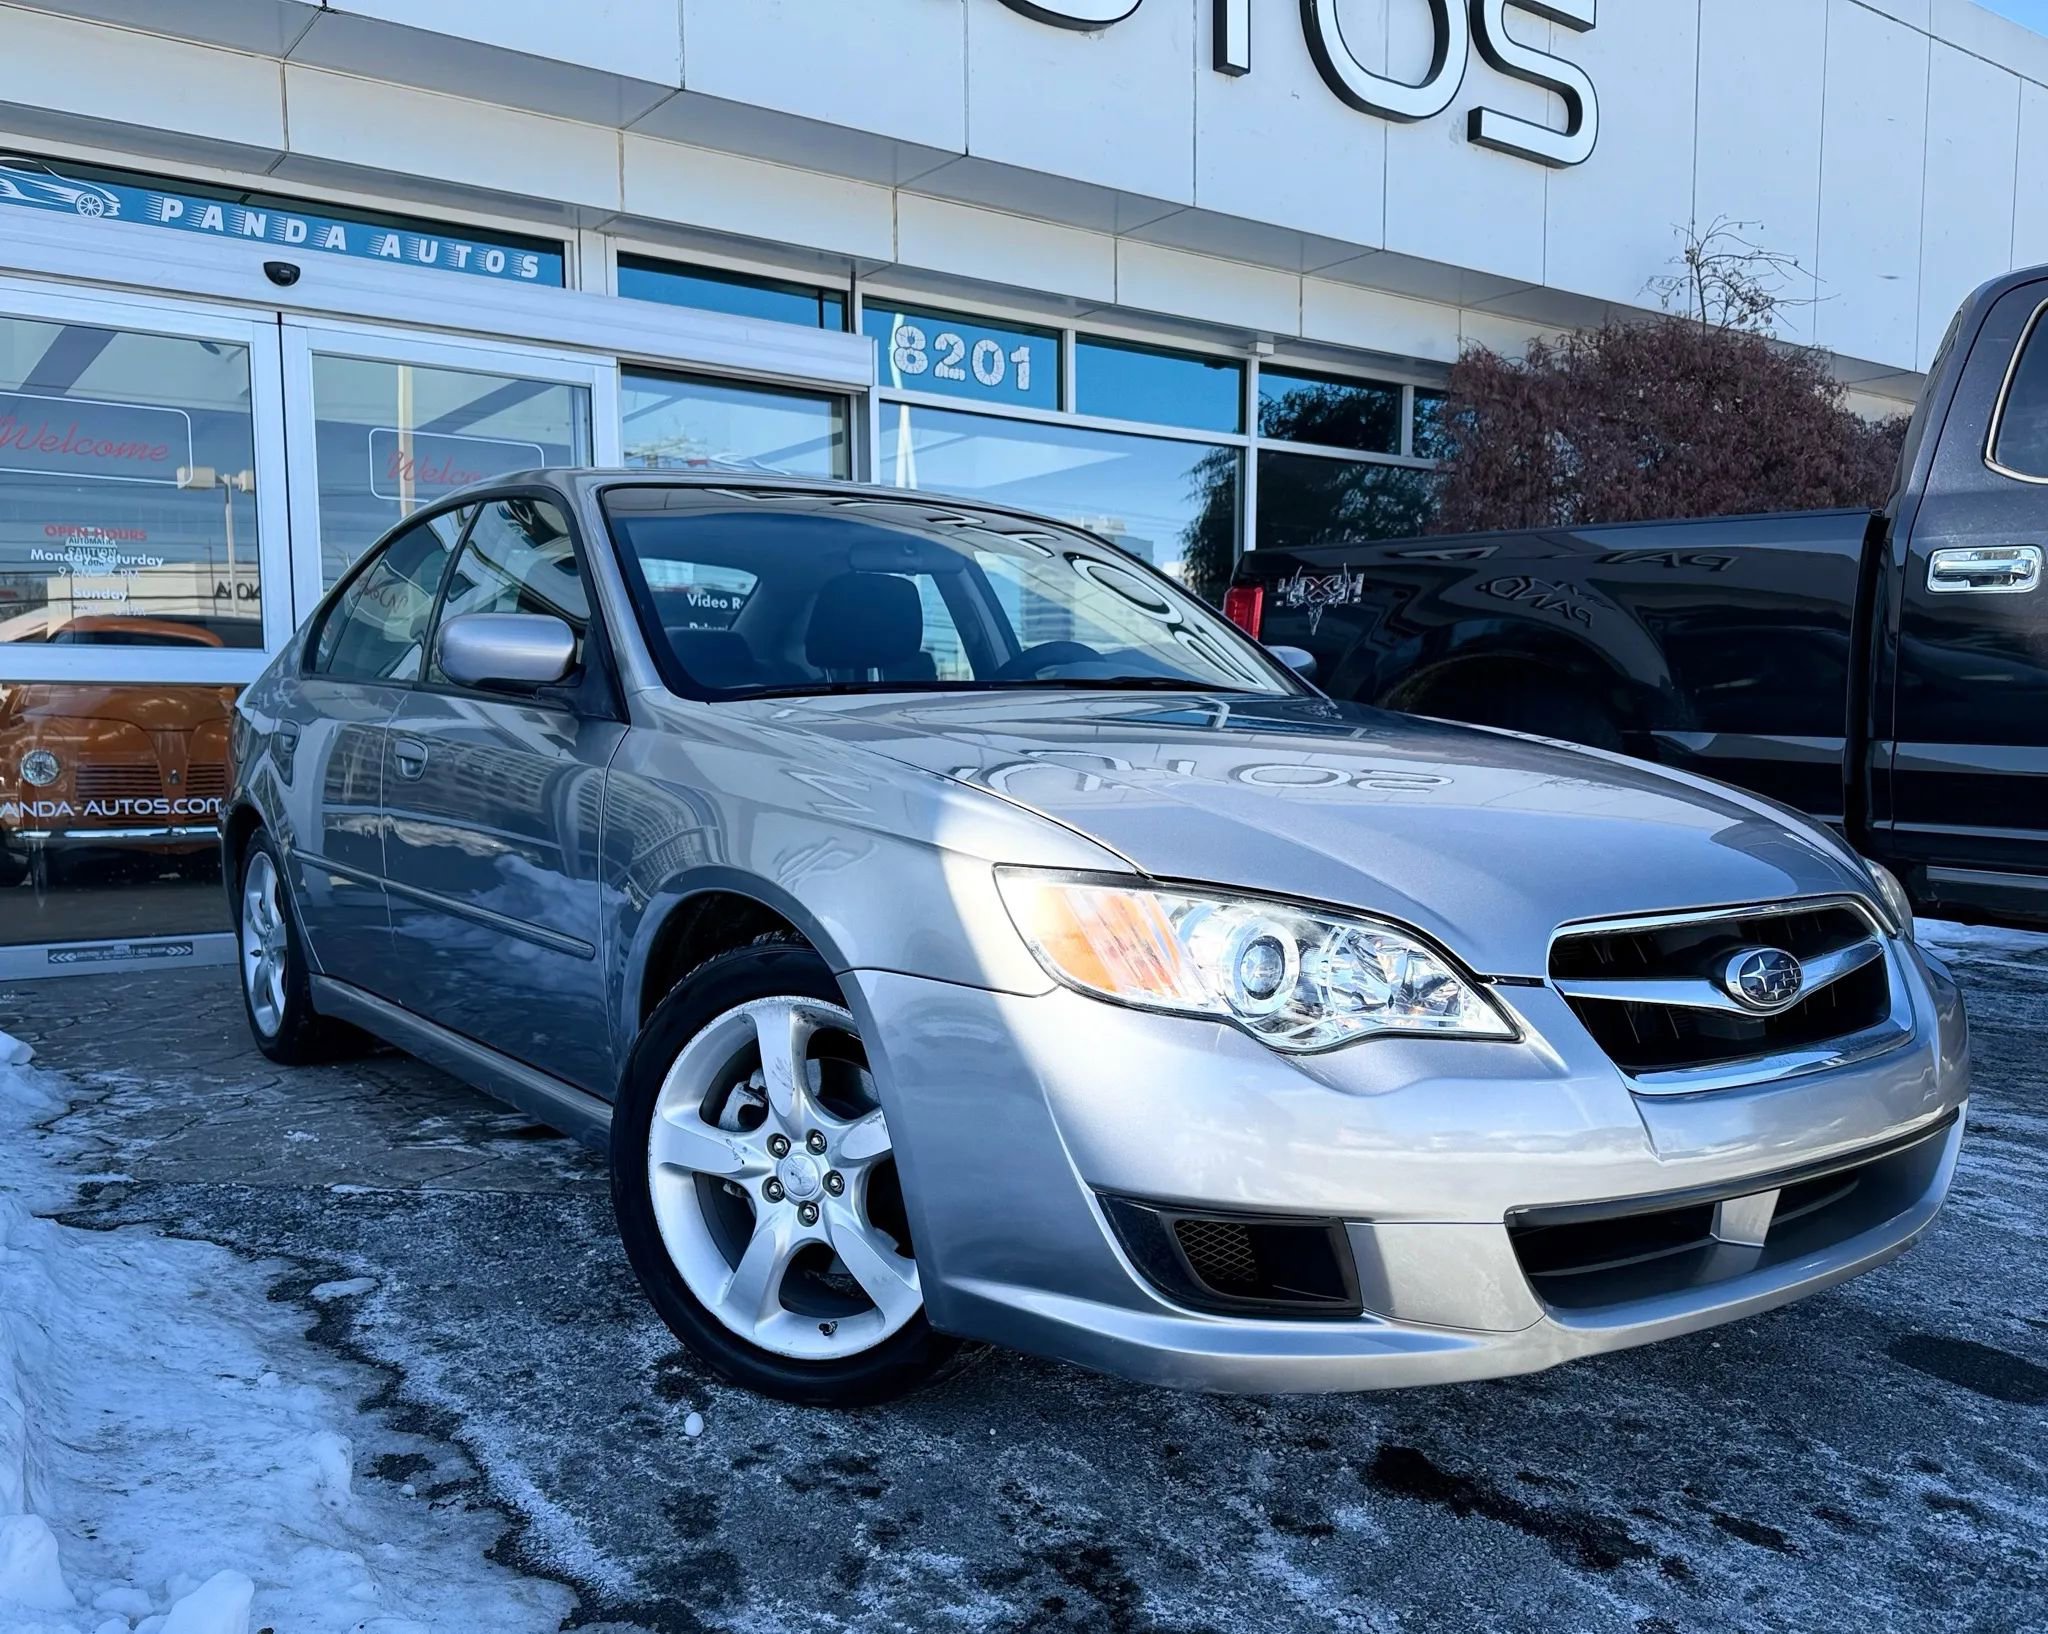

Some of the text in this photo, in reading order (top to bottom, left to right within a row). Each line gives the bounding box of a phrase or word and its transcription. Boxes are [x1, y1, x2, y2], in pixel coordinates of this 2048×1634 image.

[157, 195, 540, 279] PANDA AUTOS
[893, 325, 1031, 392] 8201
[0, 415, 169, 463] Welcome
[44, 524, 148, 542] OPEN HOURS
[57, 565, 67, 579] 9
[71, 568, 91, 579] AM
[72, 587, 129, 603] Sunday
[686, 591, 745, 610] Video R
